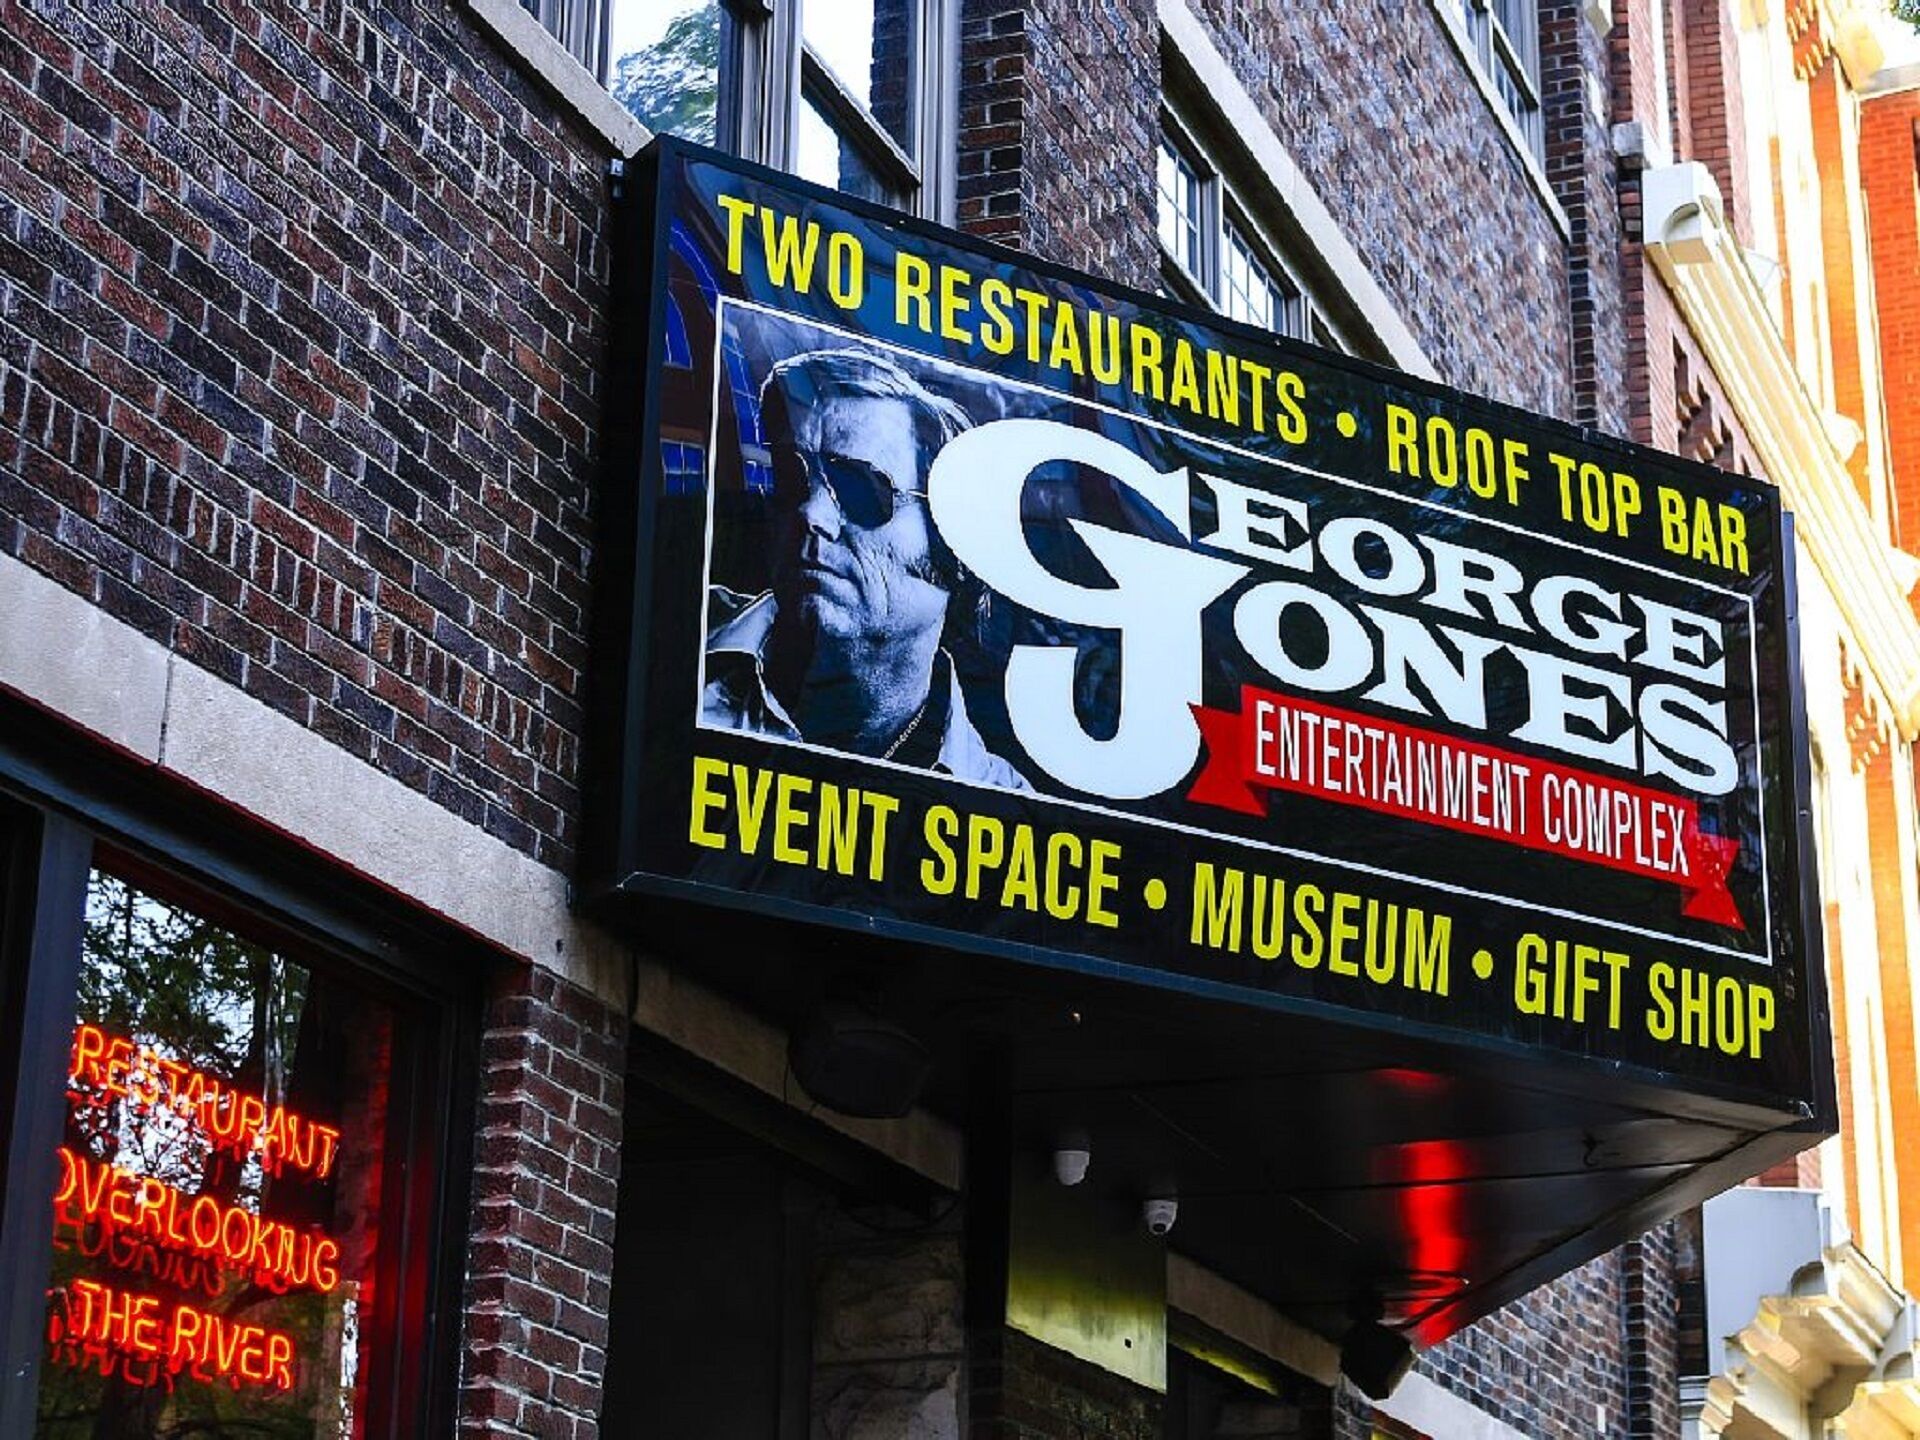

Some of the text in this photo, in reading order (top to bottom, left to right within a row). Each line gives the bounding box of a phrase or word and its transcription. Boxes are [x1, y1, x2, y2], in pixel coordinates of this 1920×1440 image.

[720, 195, 1749, 575] TWO RESTAURANTS ROOF TOP BAR
[928, 418, 1726, 689] GEORGE
[1004, 520, 1739, 799] JONES
[689, 756, 1776, 1060] EVENT SPACE MUSEUM GIFT SHOP
[1256, 700, 1691, 877] ENTERTAINMENT COMPLEX
[72, 1026, 340, 1179] RESTAURANT
[76, 1278, 160, 1352] THE
[171, 1305, 293, 1391] RIVER
